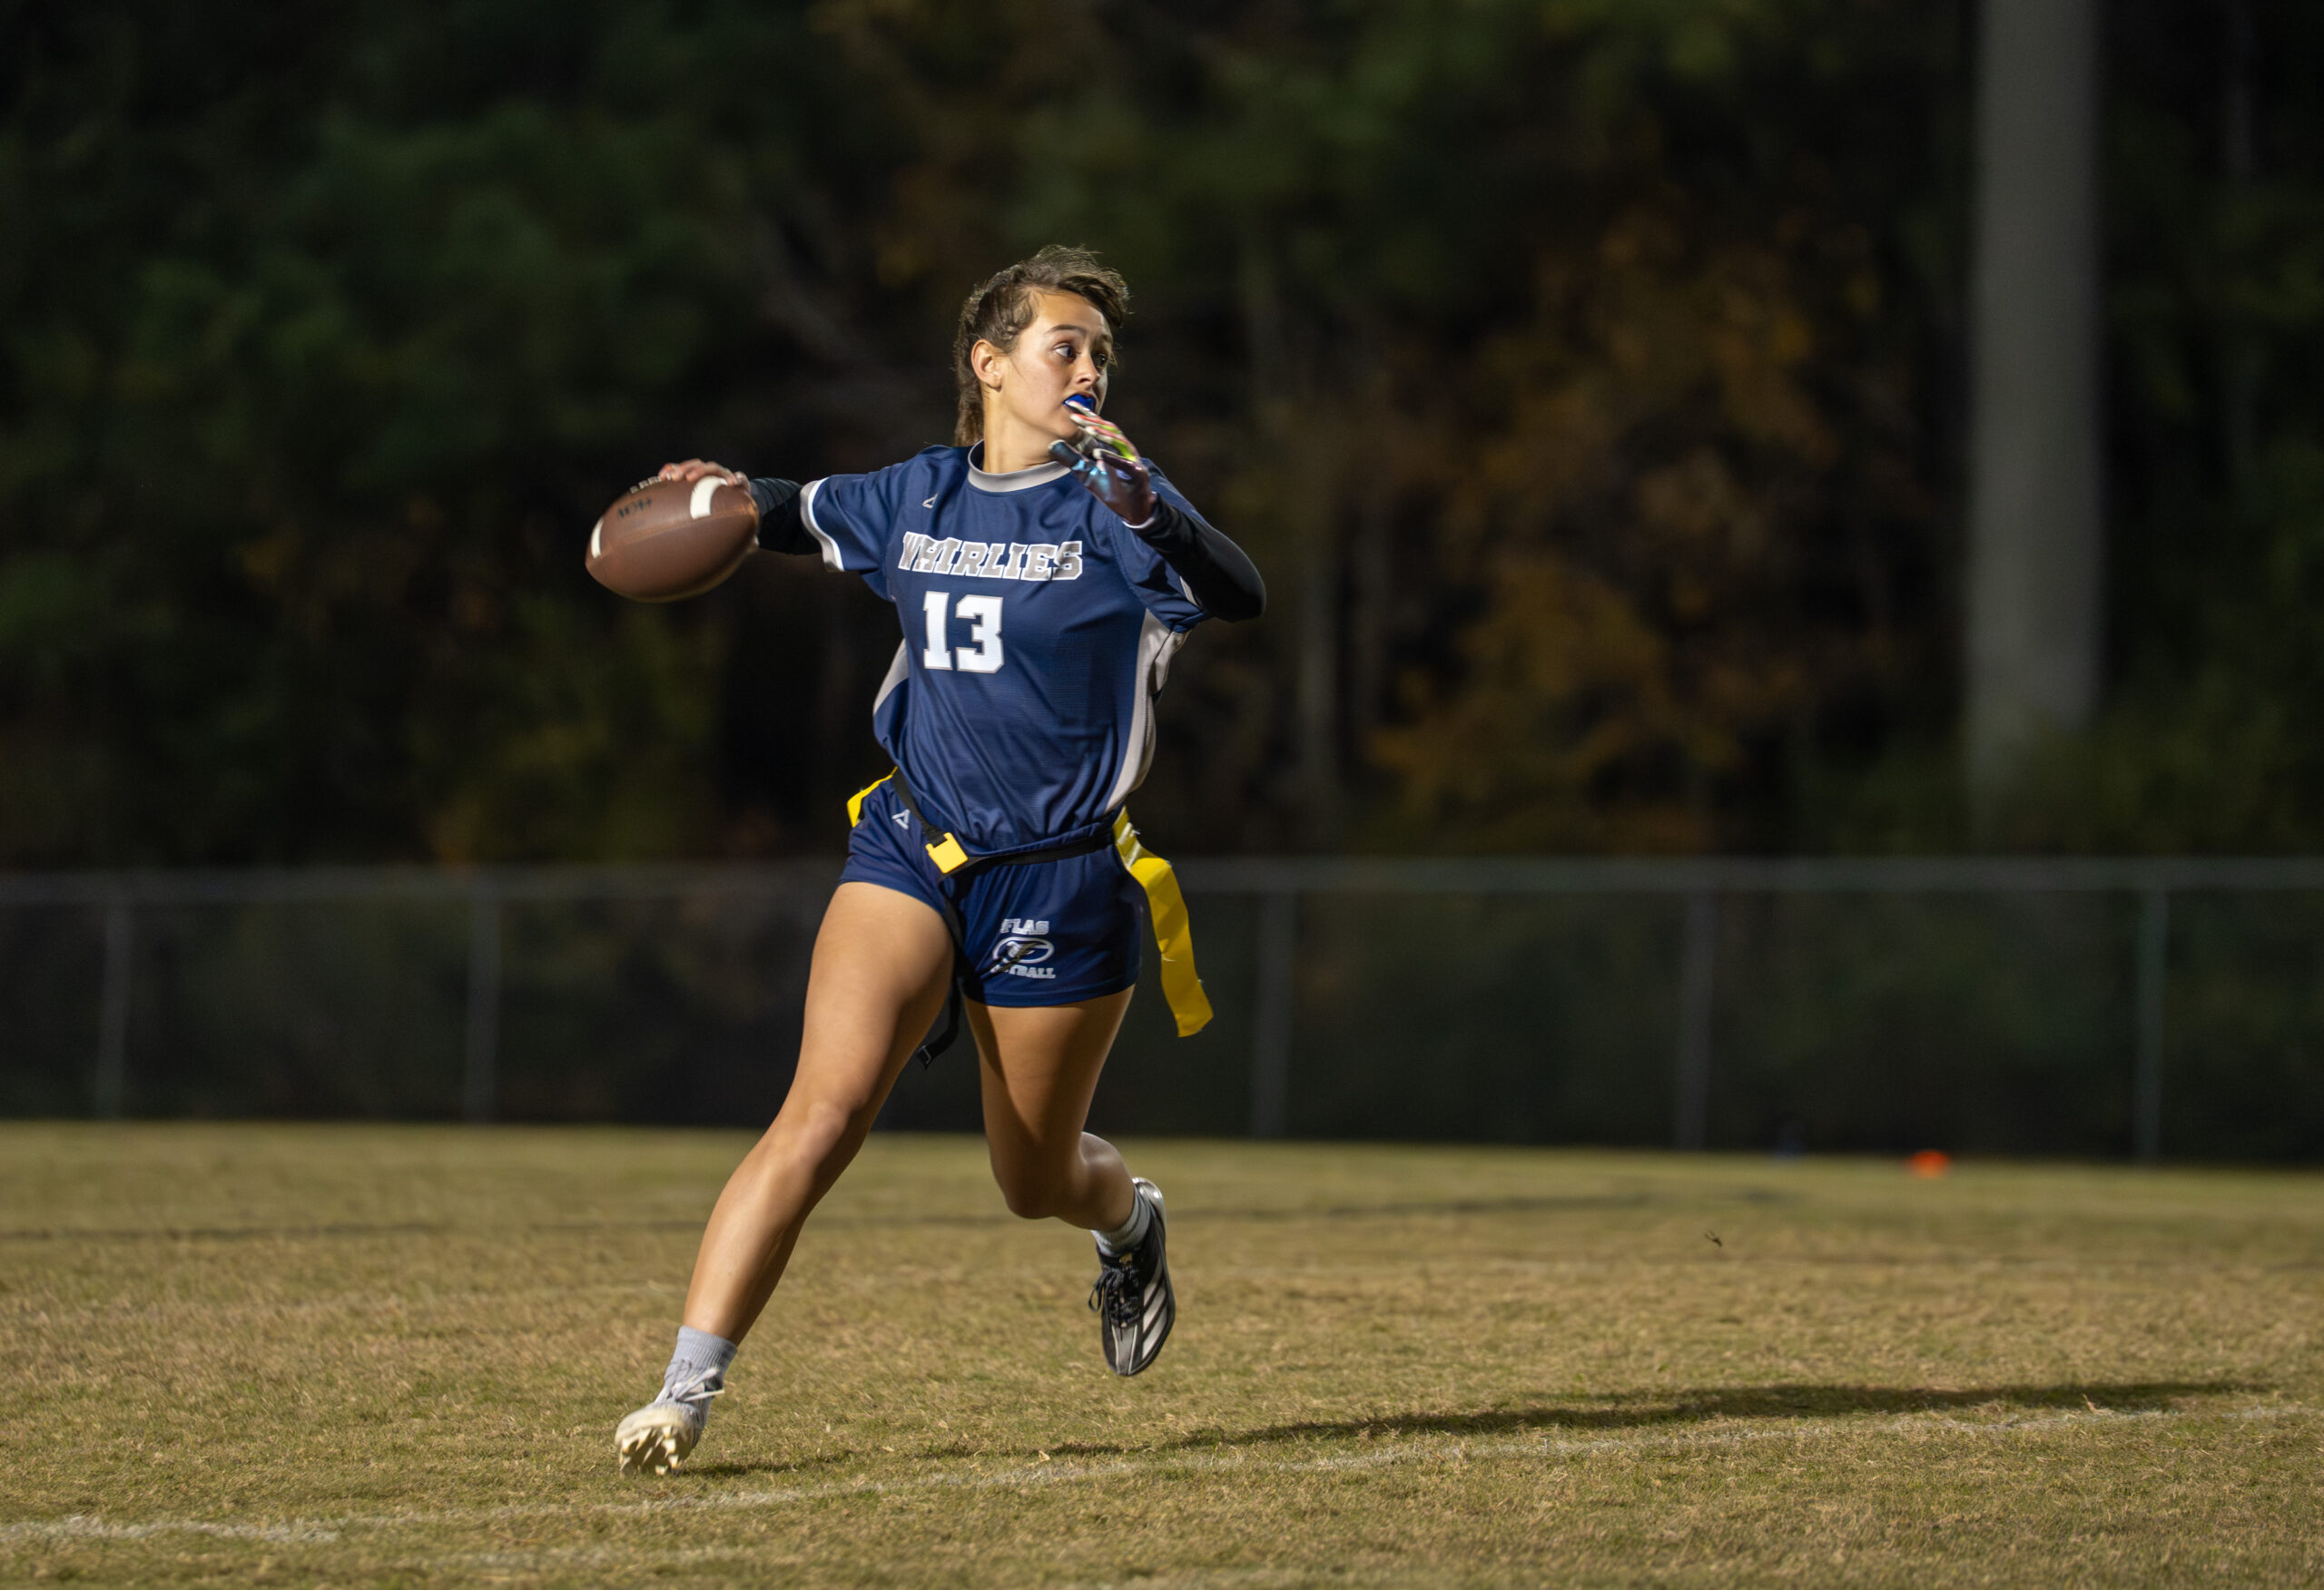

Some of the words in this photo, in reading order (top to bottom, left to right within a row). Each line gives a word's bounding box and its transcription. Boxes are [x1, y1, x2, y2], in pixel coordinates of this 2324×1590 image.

[897, 531, 1083, 581] WHIRLIES
[923, 591, 1005, 673] 13
[1000, 918, 1049, 935] FLAG
